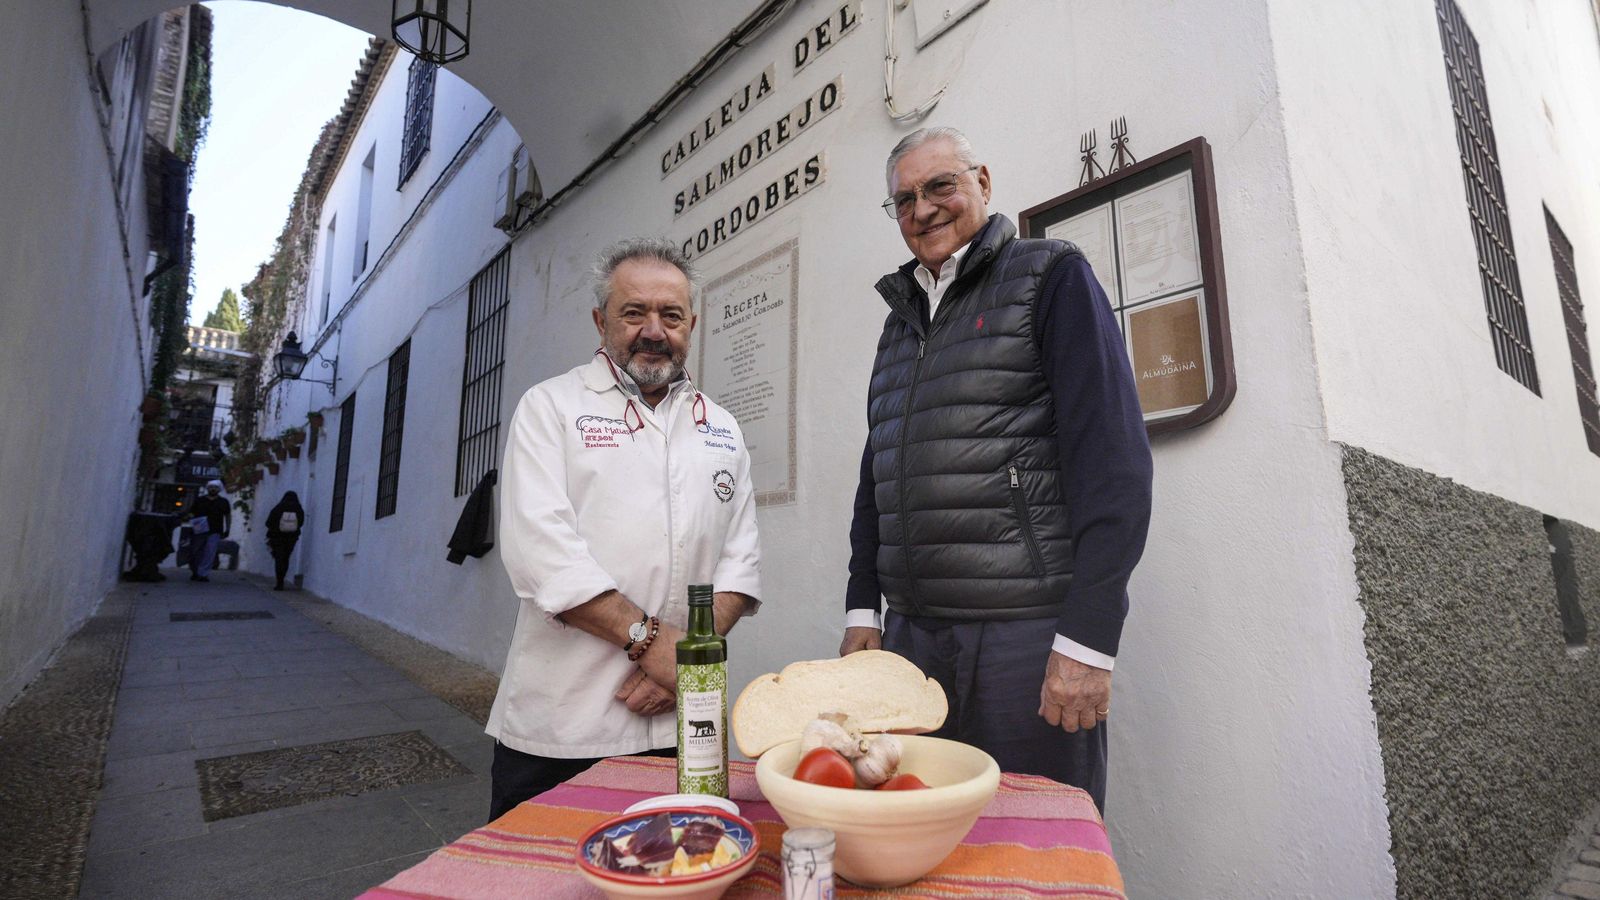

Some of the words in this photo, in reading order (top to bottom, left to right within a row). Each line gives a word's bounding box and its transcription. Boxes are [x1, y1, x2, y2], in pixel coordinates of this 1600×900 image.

[661, 71, 771, 175] CALLEJA
[794, 4, 856, 69] DEL
[674, 82, 838, 215] SALMOREJO
[683, 155, 820, 261] CORDOBES
[723, 291, 768, 320] RECETA
[1142, 361, 1197, 380] ALMUDAINA
[582, 425, 602, 434] Casa
[689, 737, 717, 745] MILUMA
